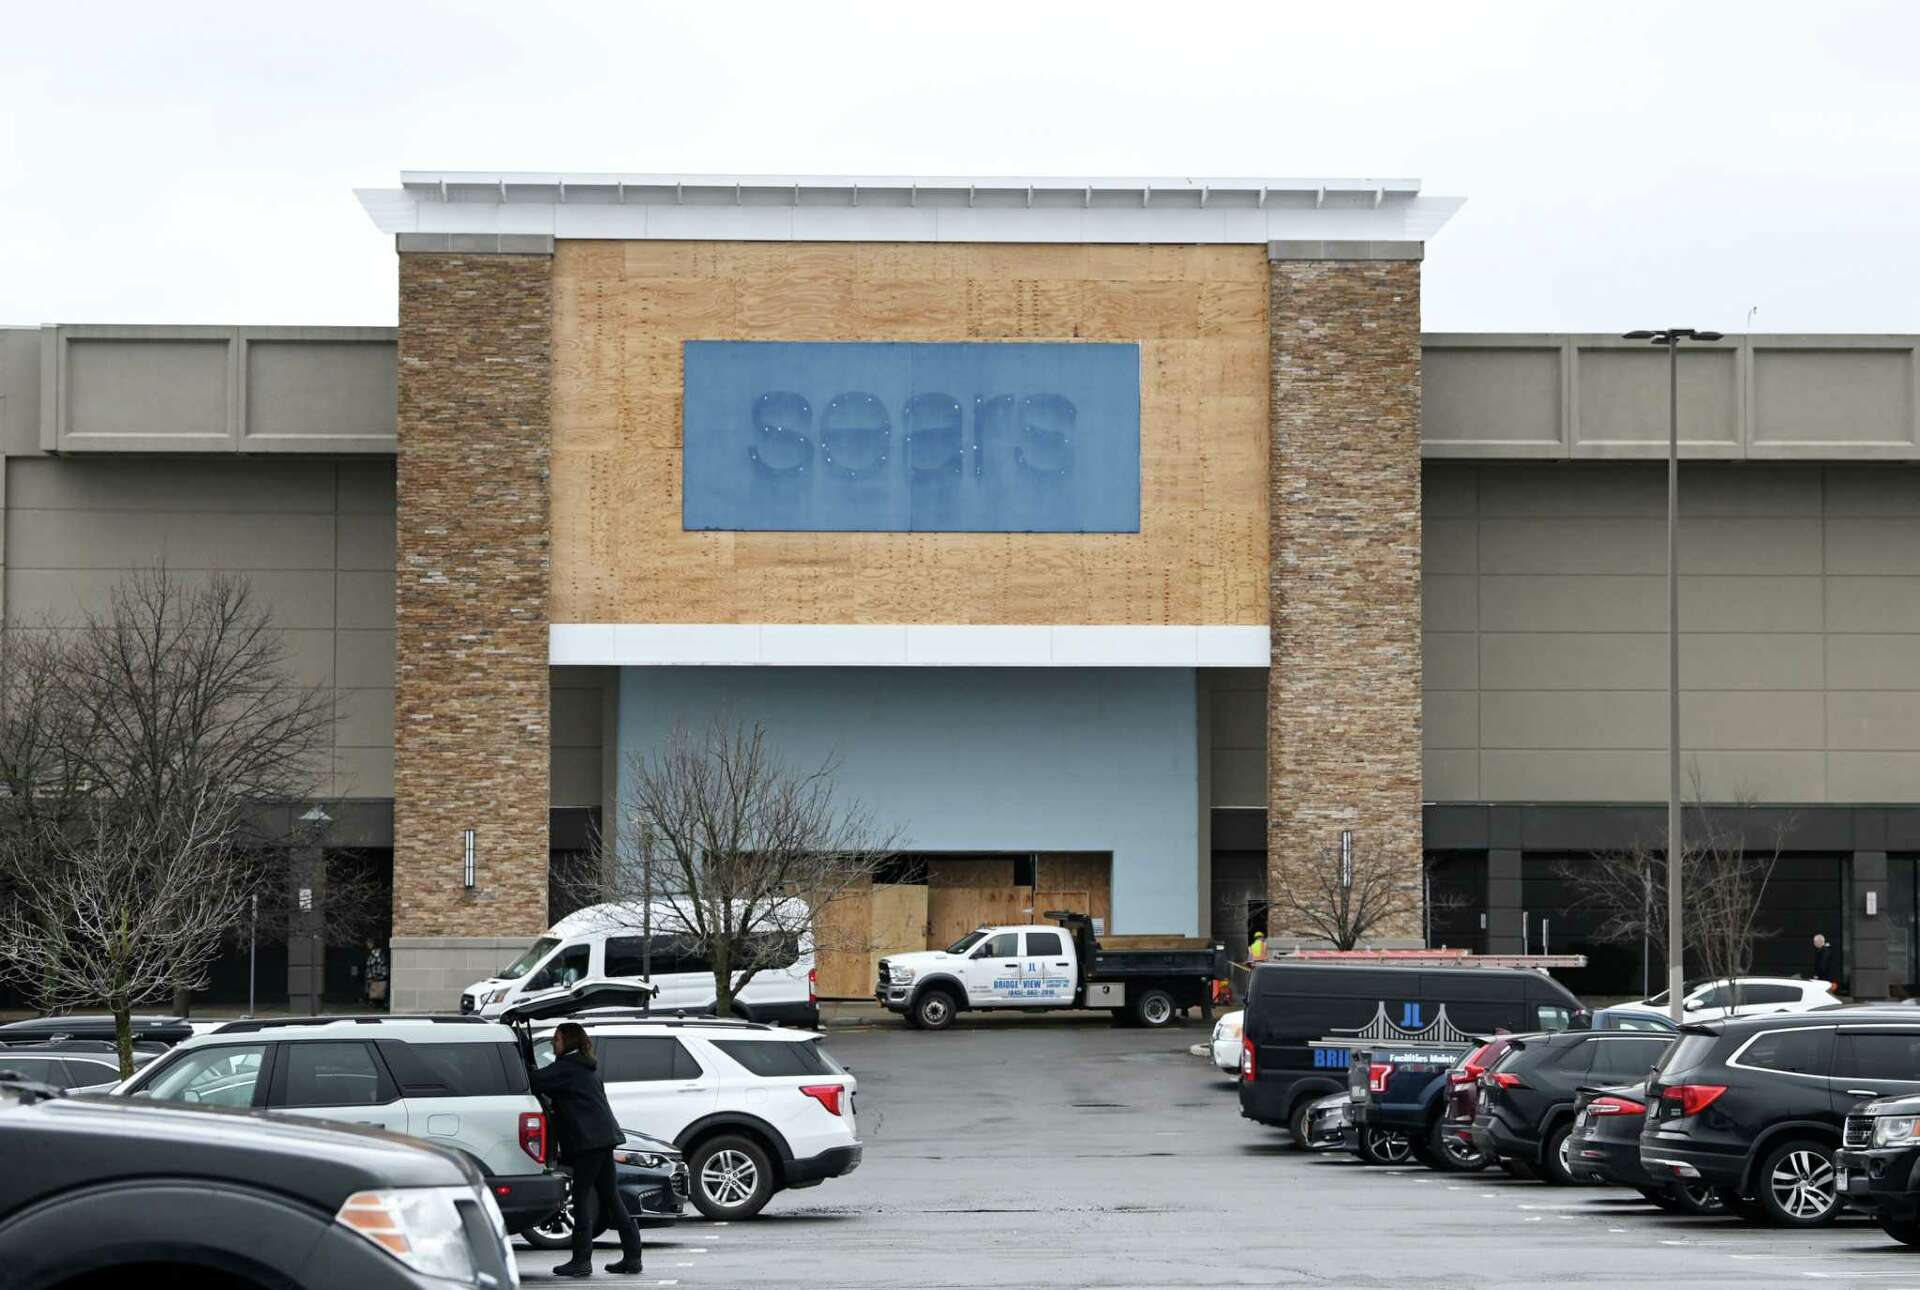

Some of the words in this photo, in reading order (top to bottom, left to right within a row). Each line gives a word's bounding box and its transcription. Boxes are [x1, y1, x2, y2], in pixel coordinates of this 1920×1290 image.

[748, 390, 1077, 480] sears
[993, 980, 1019, 989] BRIDGE
[1023, 980, 1041, 989] VIEW
[1400, 1002, 1424, 1028] JL
[1389, 1053, 1428, 1063] Facilities
